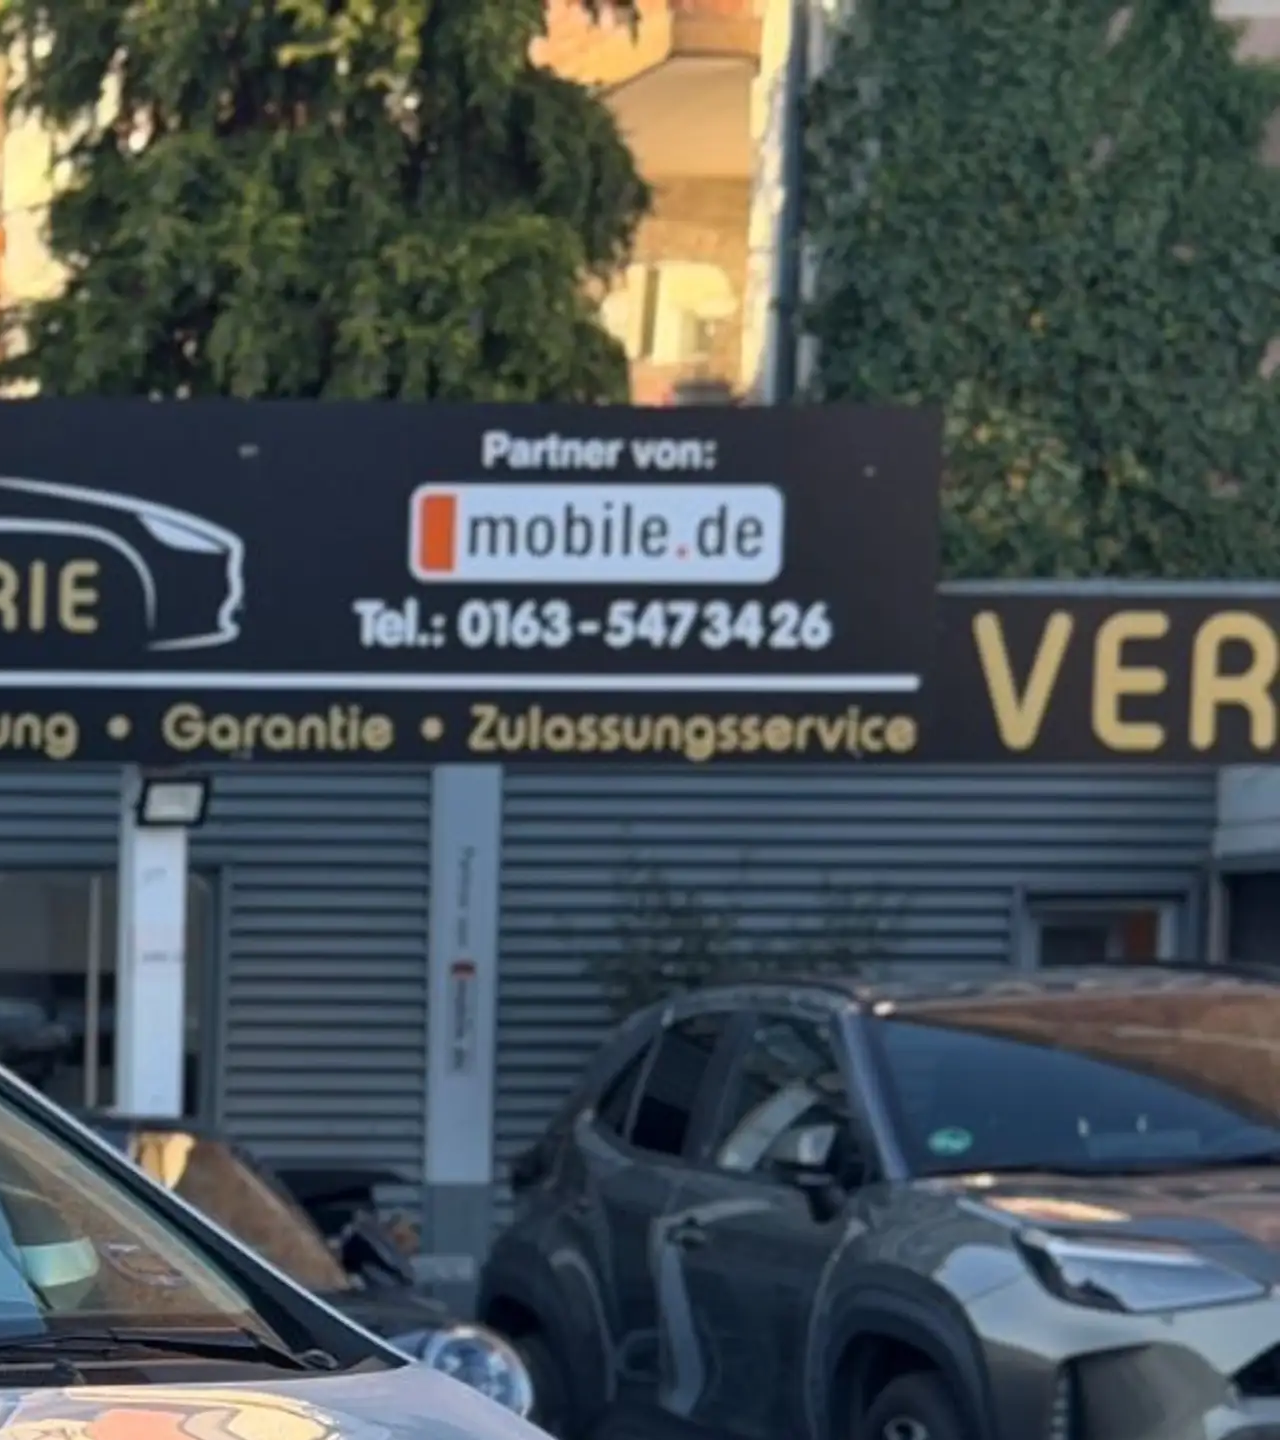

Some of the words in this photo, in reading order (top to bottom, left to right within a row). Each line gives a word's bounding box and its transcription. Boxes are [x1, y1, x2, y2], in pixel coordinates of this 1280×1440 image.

[482, 430, 624, 469] Partner
[631, 437, 717, 470] von:
[466, 501, 765, 559] mobile.de
[353, 597, 446, 649] Tel.:
[456, 600, 834, 650] 0163-5473426
[162, 704, 394, 752] Garantie
[467, 704, 918, 761] Zulassungsservice
